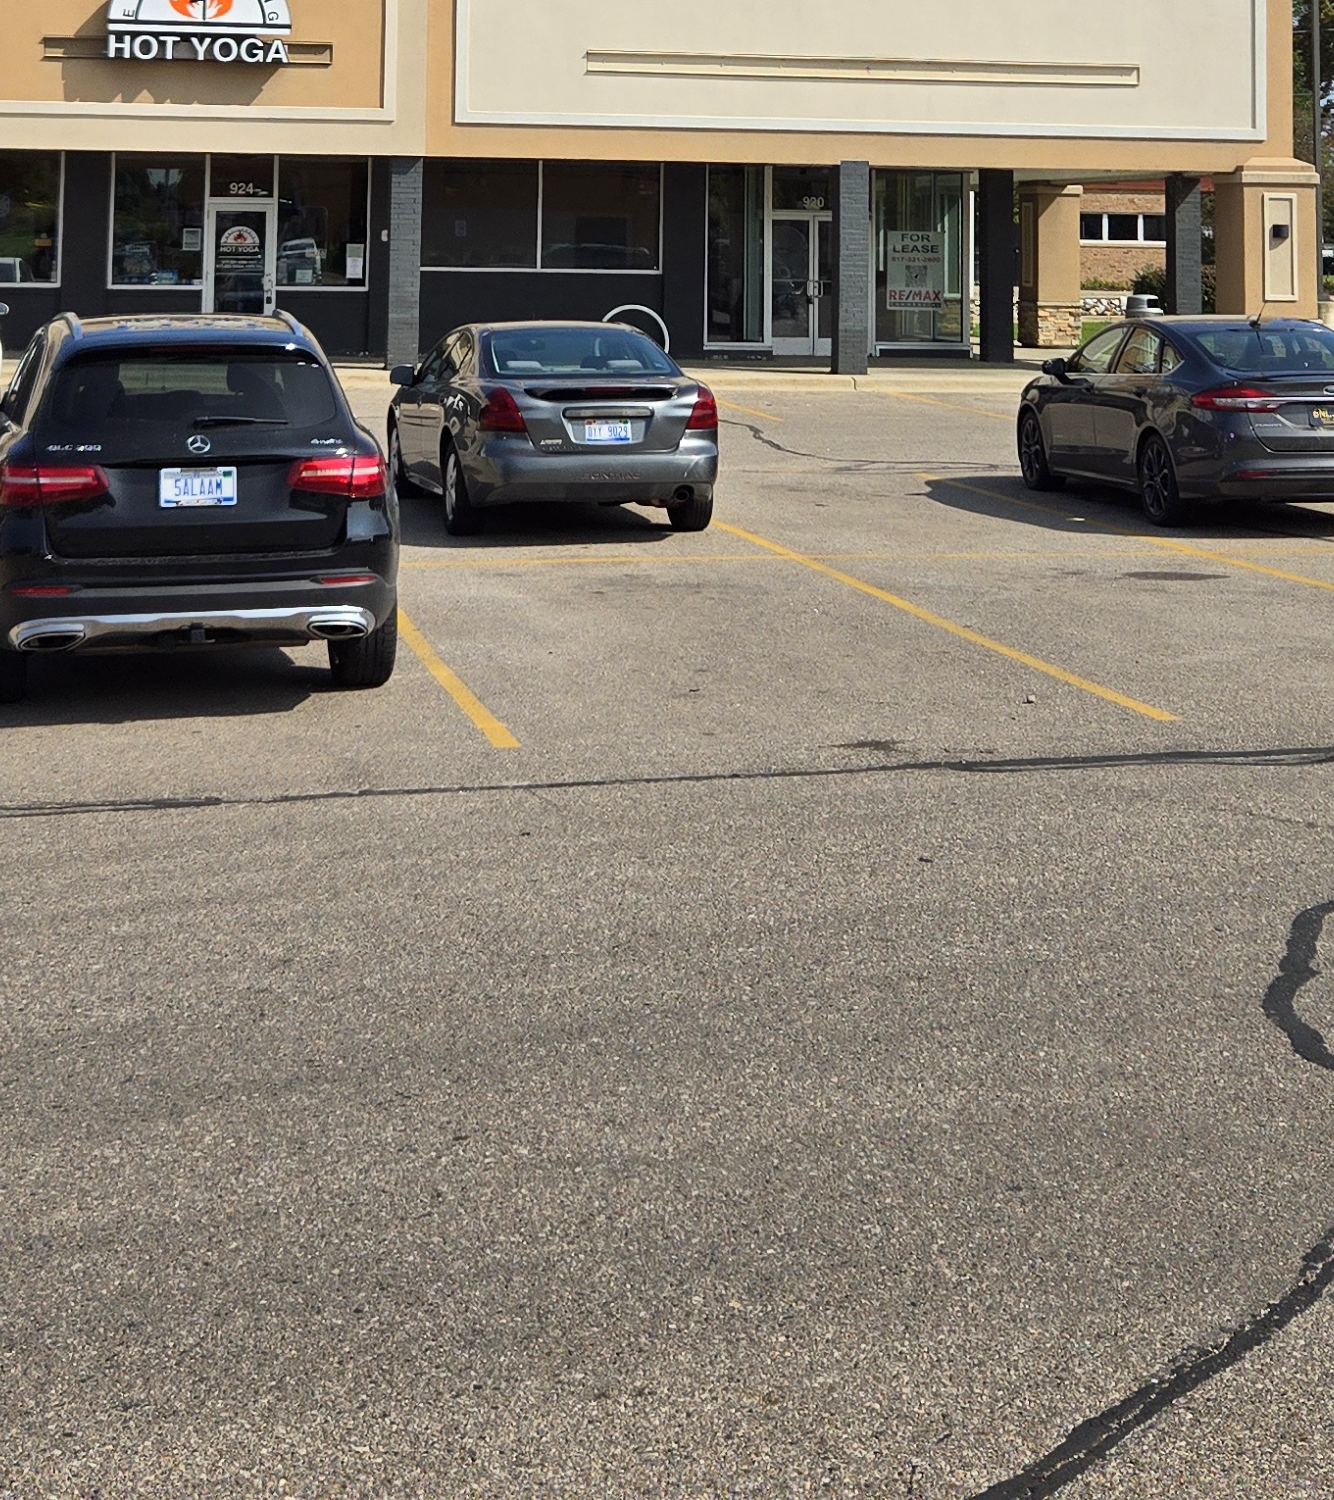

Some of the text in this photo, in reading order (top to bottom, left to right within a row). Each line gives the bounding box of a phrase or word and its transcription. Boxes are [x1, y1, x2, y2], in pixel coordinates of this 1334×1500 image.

[108, 34, 289, 63] HOT YOGA
[229, 182, 254, 194] 924
[802, 196, 825, 209] 920
[901, 233, 931, 242] FOR
[892, 244, 940, 253] LEASE
[888, 289, 941, 301] RE/MAX
[607, 425, 628, 438] 9029
[582, 471, 642, 480] PONTIAC
